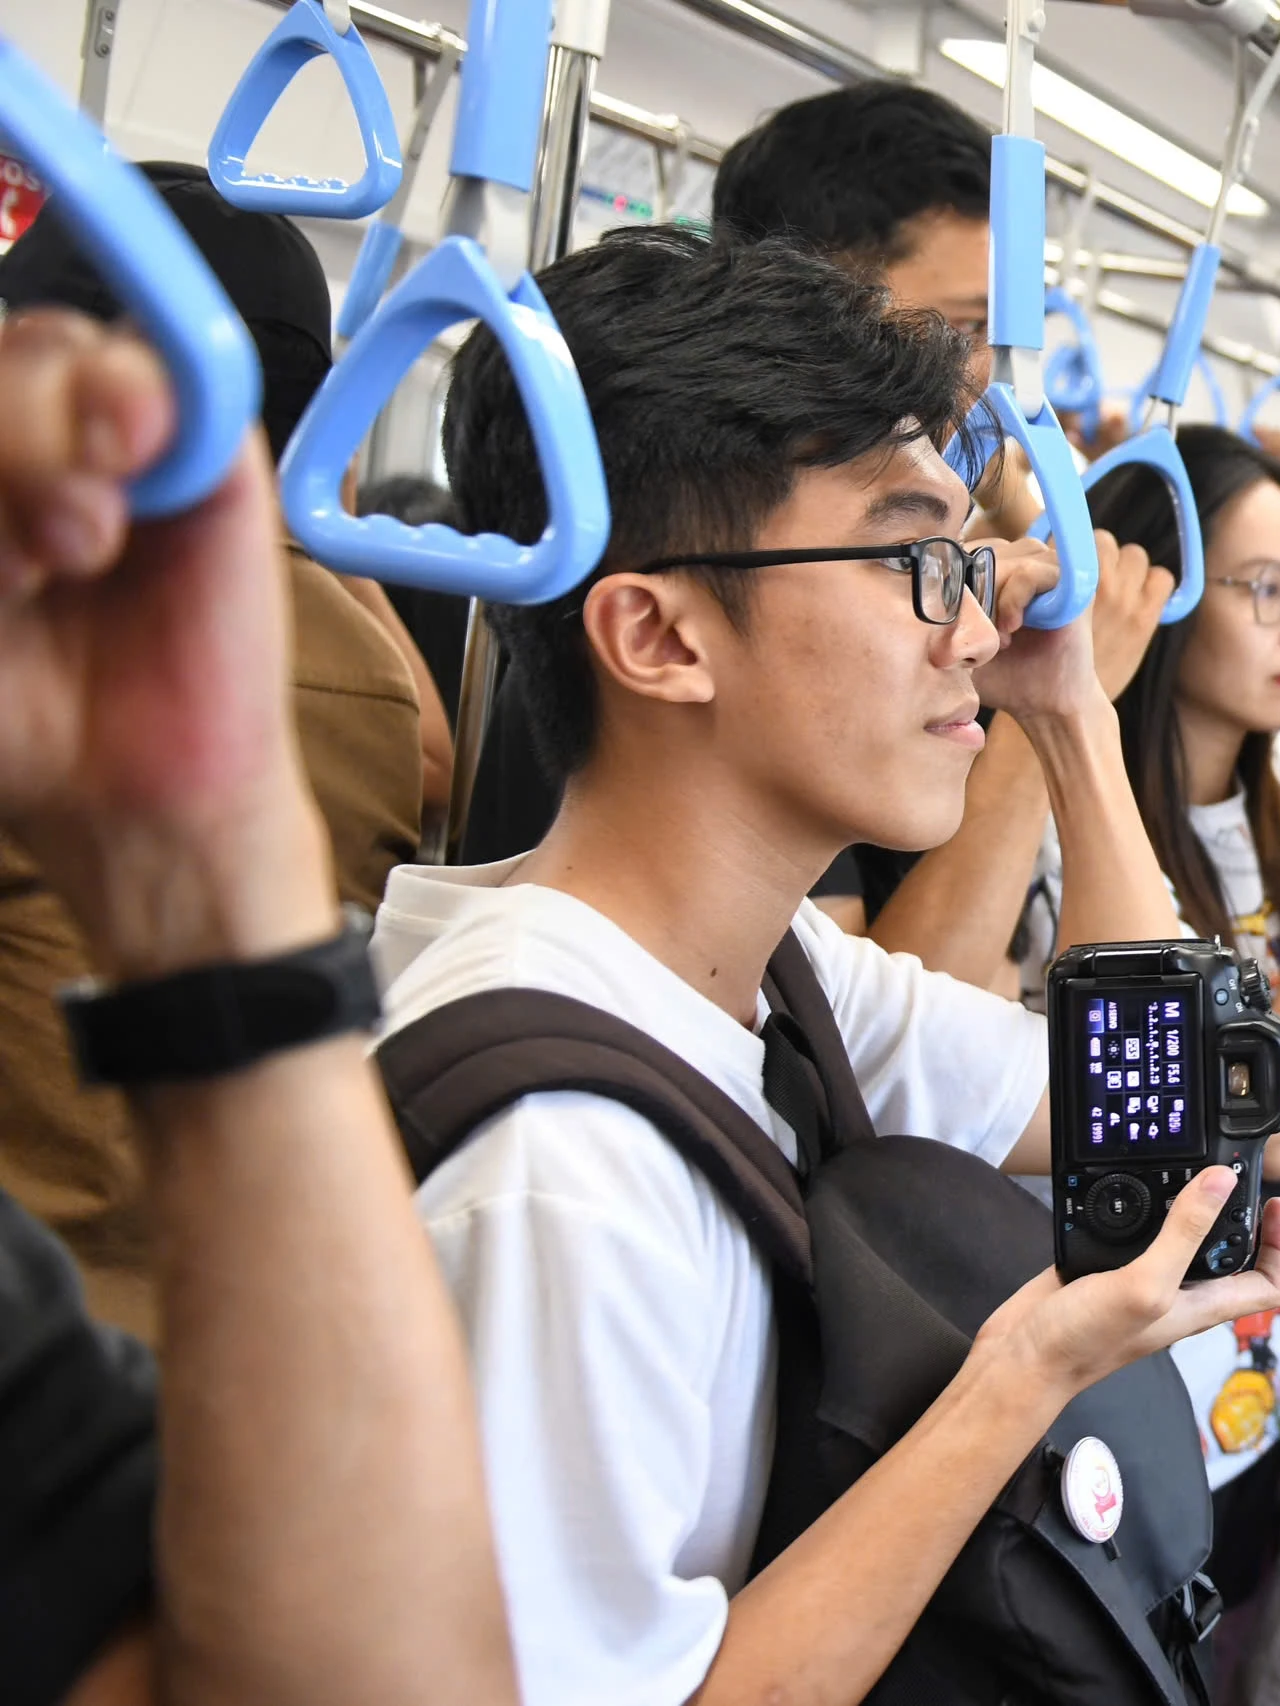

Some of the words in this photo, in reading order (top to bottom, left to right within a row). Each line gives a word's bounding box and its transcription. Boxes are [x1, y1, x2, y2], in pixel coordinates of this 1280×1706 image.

[1228, 978, 1237, 990] OFF
[1164, 1001, 1180, 1018] M
[1235, 1002, 1243, 1013] ON
[1108, 1009, 1117, 1030] SERVO
[1166, 1029, 1180, 1056] 1/200
[1167, 1063, 1180, 1083] F5.6
[1091, 1107, 1102, 1117] 42
[1092, 1123, 1103, 1143] (999)
[1065, 1197, 1073, 1215] UNLOCK
[1114, 1201, 1122, 1214] SET
